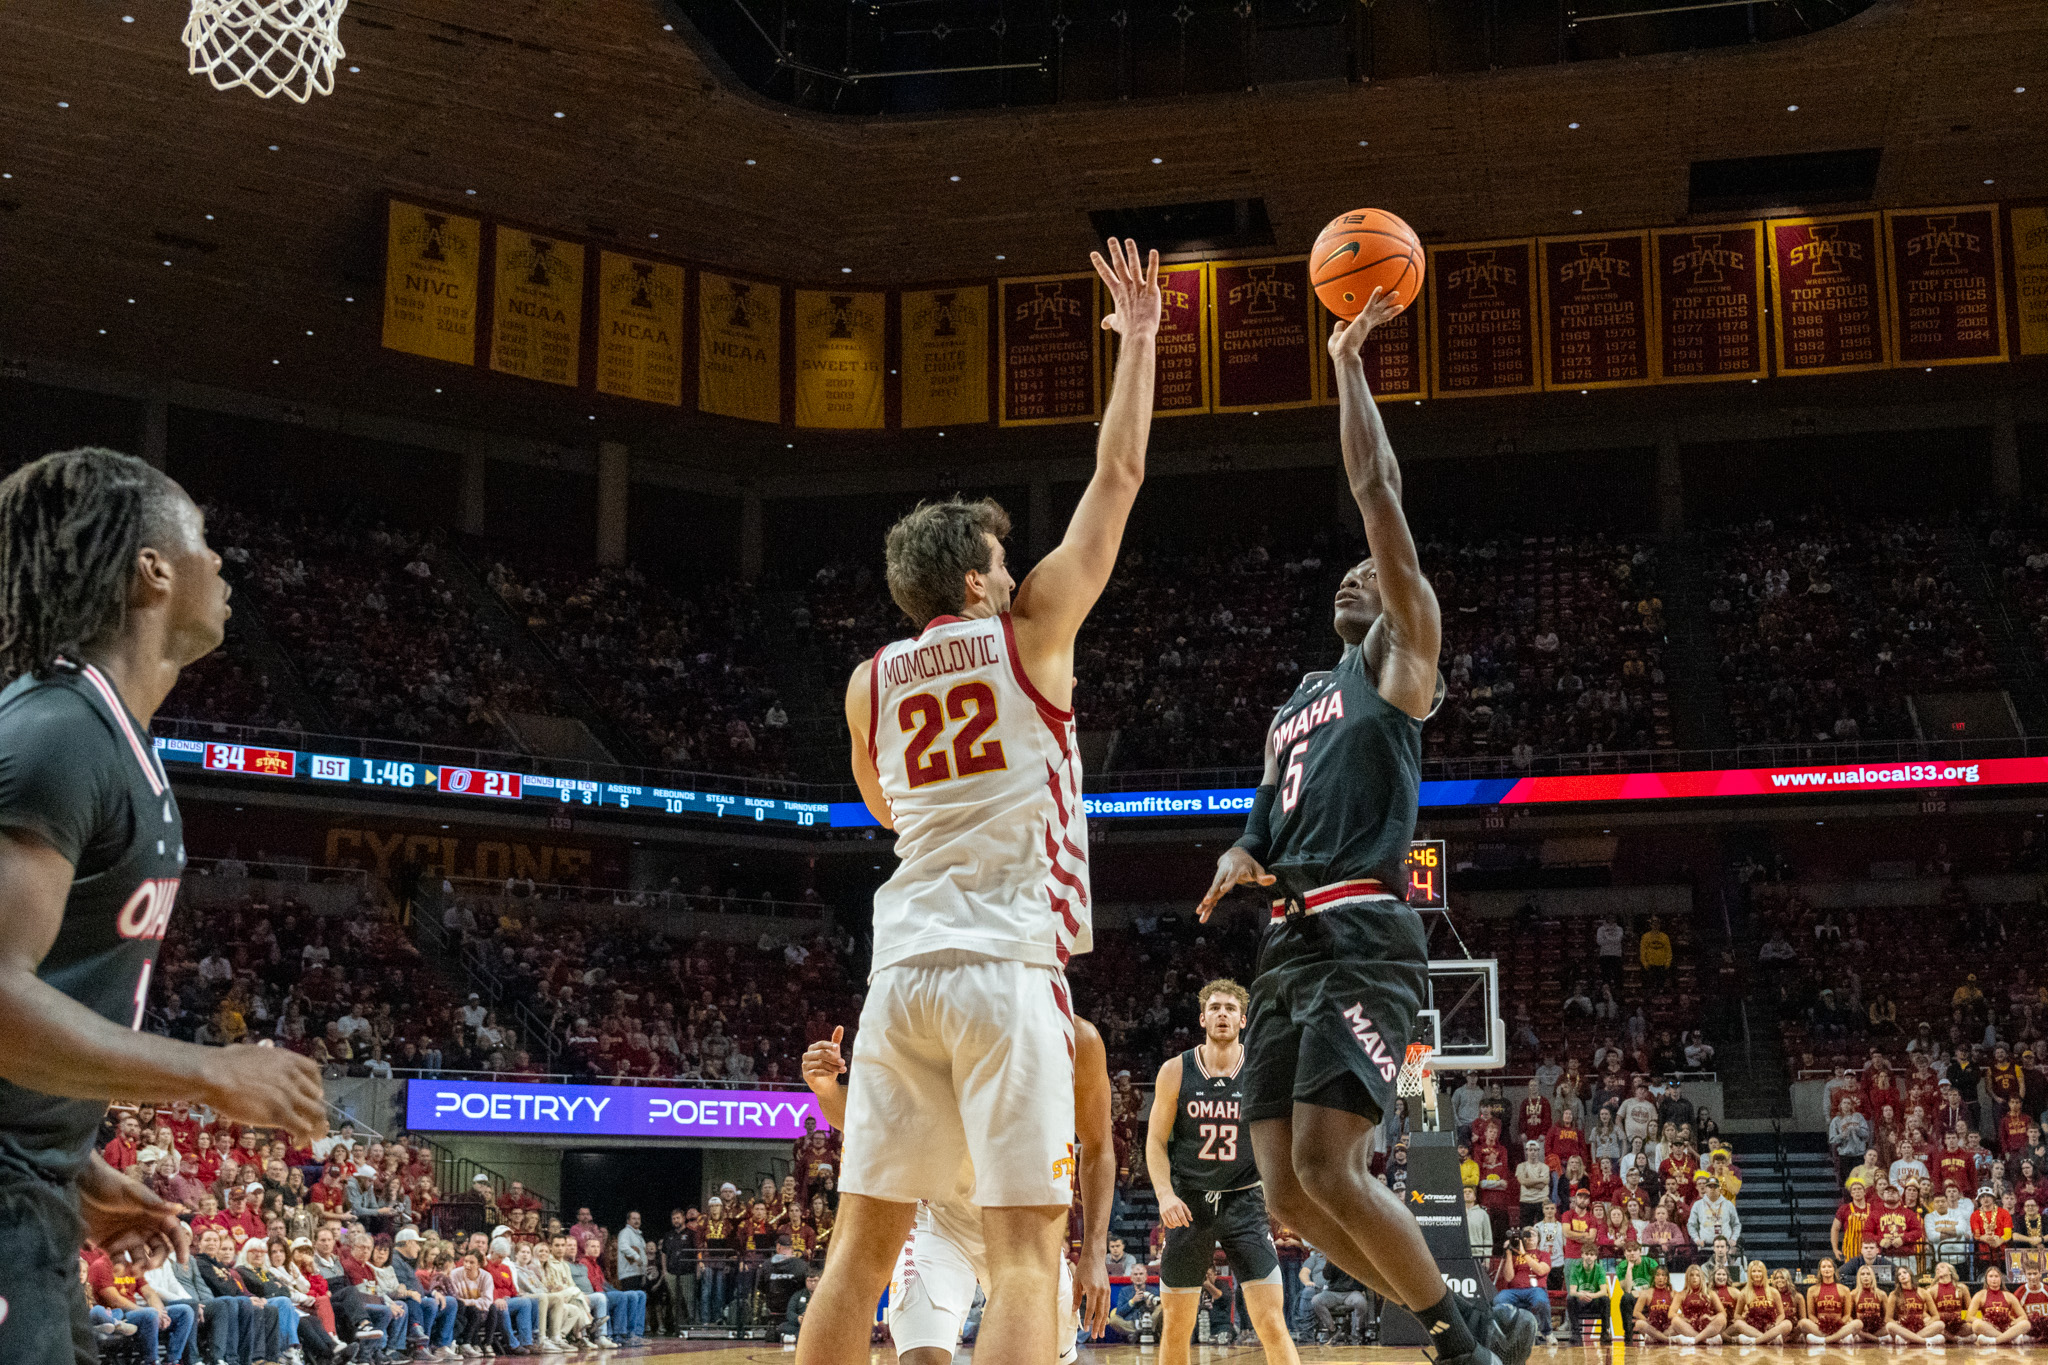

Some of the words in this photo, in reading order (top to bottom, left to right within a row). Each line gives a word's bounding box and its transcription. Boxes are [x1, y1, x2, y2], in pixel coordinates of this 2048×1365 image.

[1906, 231, 1981, 257] STATE
[1789, 239, 1864, 267] STATE
[1560, 257, 1631, 283] STATE
[1672, 250, 1745, 275] STATE
[1447, 265, 1518, 290] STATE
[1907, 279, 1939, 291] TOP
[1943, 276, 1986, 289] FOUR
[405, 274, 459, 300] NIVC
[1228, 280, 1296, 305] STATE
[1791, 287, 1822, 301] TOP
[1826, 284, 1868, 297] FOUR
[1672, 296, 1703, 308] TOP
[1706, 293, 1749, 306] FOUR
[1908, 289, 1987, 303] FINISHES
[508, 299, 566, 325] NCAA
[1016, 298, 1082, 322] STATE
[1560, 304, 1590, 316] TOP
[1593, 301, 1635, 314] FOUR
[1791, 296, 1869, 313] FINISHES
[1956, 304, 1988, 314] 2002
[1448, 311, 1477, 323] TOP
[1481, 308, 1521, 321] FOUR
[1672, 305, 1749, 320] FINISHES
[1448, 319, 1522, 335] FINISHES
[1560, 313, 1636, 328] FINISHES
[1672, 323, 1704, 335] 1977
[1717, 321, 1749, 332] 1978
[1909, 319, 1940, 330] 2007
[612, 321, 670, 346] NCAA
[1224, 325, 1302, 339] CONFERENCE
[1560, 331, 1591, 341] 1969
[1604, 327, 1636, 339] 1970
[1910, 333, 1942, 344] 2010
[1957, 329, 1990, 341] 2024
[1011, 341, 1087, 354] CONFERENCE
[1223, 335, 1305, 351] CHAMPIONS
[1492, 335, 1522, 346] 1961
[1560, 343, 1591, 354] 1971
[1604, 340, 1637, 351] 1972
[1672, 337, 1704, 347] 1979
[1793, 341, 1826, 352] 1992
[713, 341, 767, 363] NCAA
[1009, 350, 1089, 365] CHAMPIONS
[1228, 353, 1259, 365] 2024
[1492, 347, 1522, 359] 1964
[1794, 353, 1826, 366] 1997
[802, 359, 858, 372] SWEET
[863, 361, 879, 371] 16
[1162, 358, 1193, 369] 1979
[1561, 356, 1592, 367] 1973
[1606, 353, 1637, 364] 1974
[1054, 365, 1085, 376] 1937
[1161, 370, 1193, 382] 1982
[1561, 369, 1593, 381] 1975
[1606, 366, 1638, 377] 1976
[825, 379, 855, 388] 2007
[1013, 381, 1044, 391] 1941
[1054, 379, 1085, 388] 1942
[1162, 382, 1193, 394] 2007
[1014, 393, 1044, 404] 1947
[1013, 405, 1045, 416] 1970
[1054, 403, 1085, 413] 1976
[883, 634, 999, 688] MOMCILOVIC
[1273, 690, 1344, 758] OMAHA
[898, 680, 1008, 790] 22
[169, 740, 202, 752] BONUS
[212, 745, 245, 771] 34
[255, 757, 288, 770] STATE
[317, 759, 345, 777] 1ST
[362, 759, 415, 787] 1:46
[1282, 739, 1309, 814] 5
[1771, 764, 1980, 787] www.ualocal33.org
[484, 772, 513, 796] 21
[525, 777, 553, 786] BONUS
[559, 780, 573, 788] FLS
[580, 782, 594, 790] TOL
[561, 789, 570, 803] 6
[582, 791, 592, 805] 3
[607, 784, 642, 795] ASSISTS
[653, 789, 695, 800] REBOUNDS
[620, 794, 629, 808] 5
[666, 799, 683, 813] 10
[706, 794, 735, 804] STEALS
[745, 798, 775, 808] BLOCKS
[784, 802, 829, 812] TURNOVERS
[1084, 797, 1202, 814] Steamfitters
[1207, 795, 1254, 811] Loca
[1922, 801, 1947, 813] 102
[716, 804, 725, 818] 7
[755, 808, 764, 821] 0
[797, 812, 814, 826] 10
[1485, 818, 1505, 828] 101
[1405, 848, 1437, 867] :46
[1406, 871, 1432, 901] 4
[1343, 1002, 1397, 1083] MAVS
[435, 1091, 611, 1122] POETRYY
[648, 1098, 810, 1128] POETRYY
[1187, 1101, 1241, 1119] OMAH
[1198, 1124, 1238, 1161] 23
[1898, 1168, 1920, 1176] IOWA
[1880, 1213, 1906, 1232] CYCLONES
[1817, 1300, 1841, 1308] STATE
